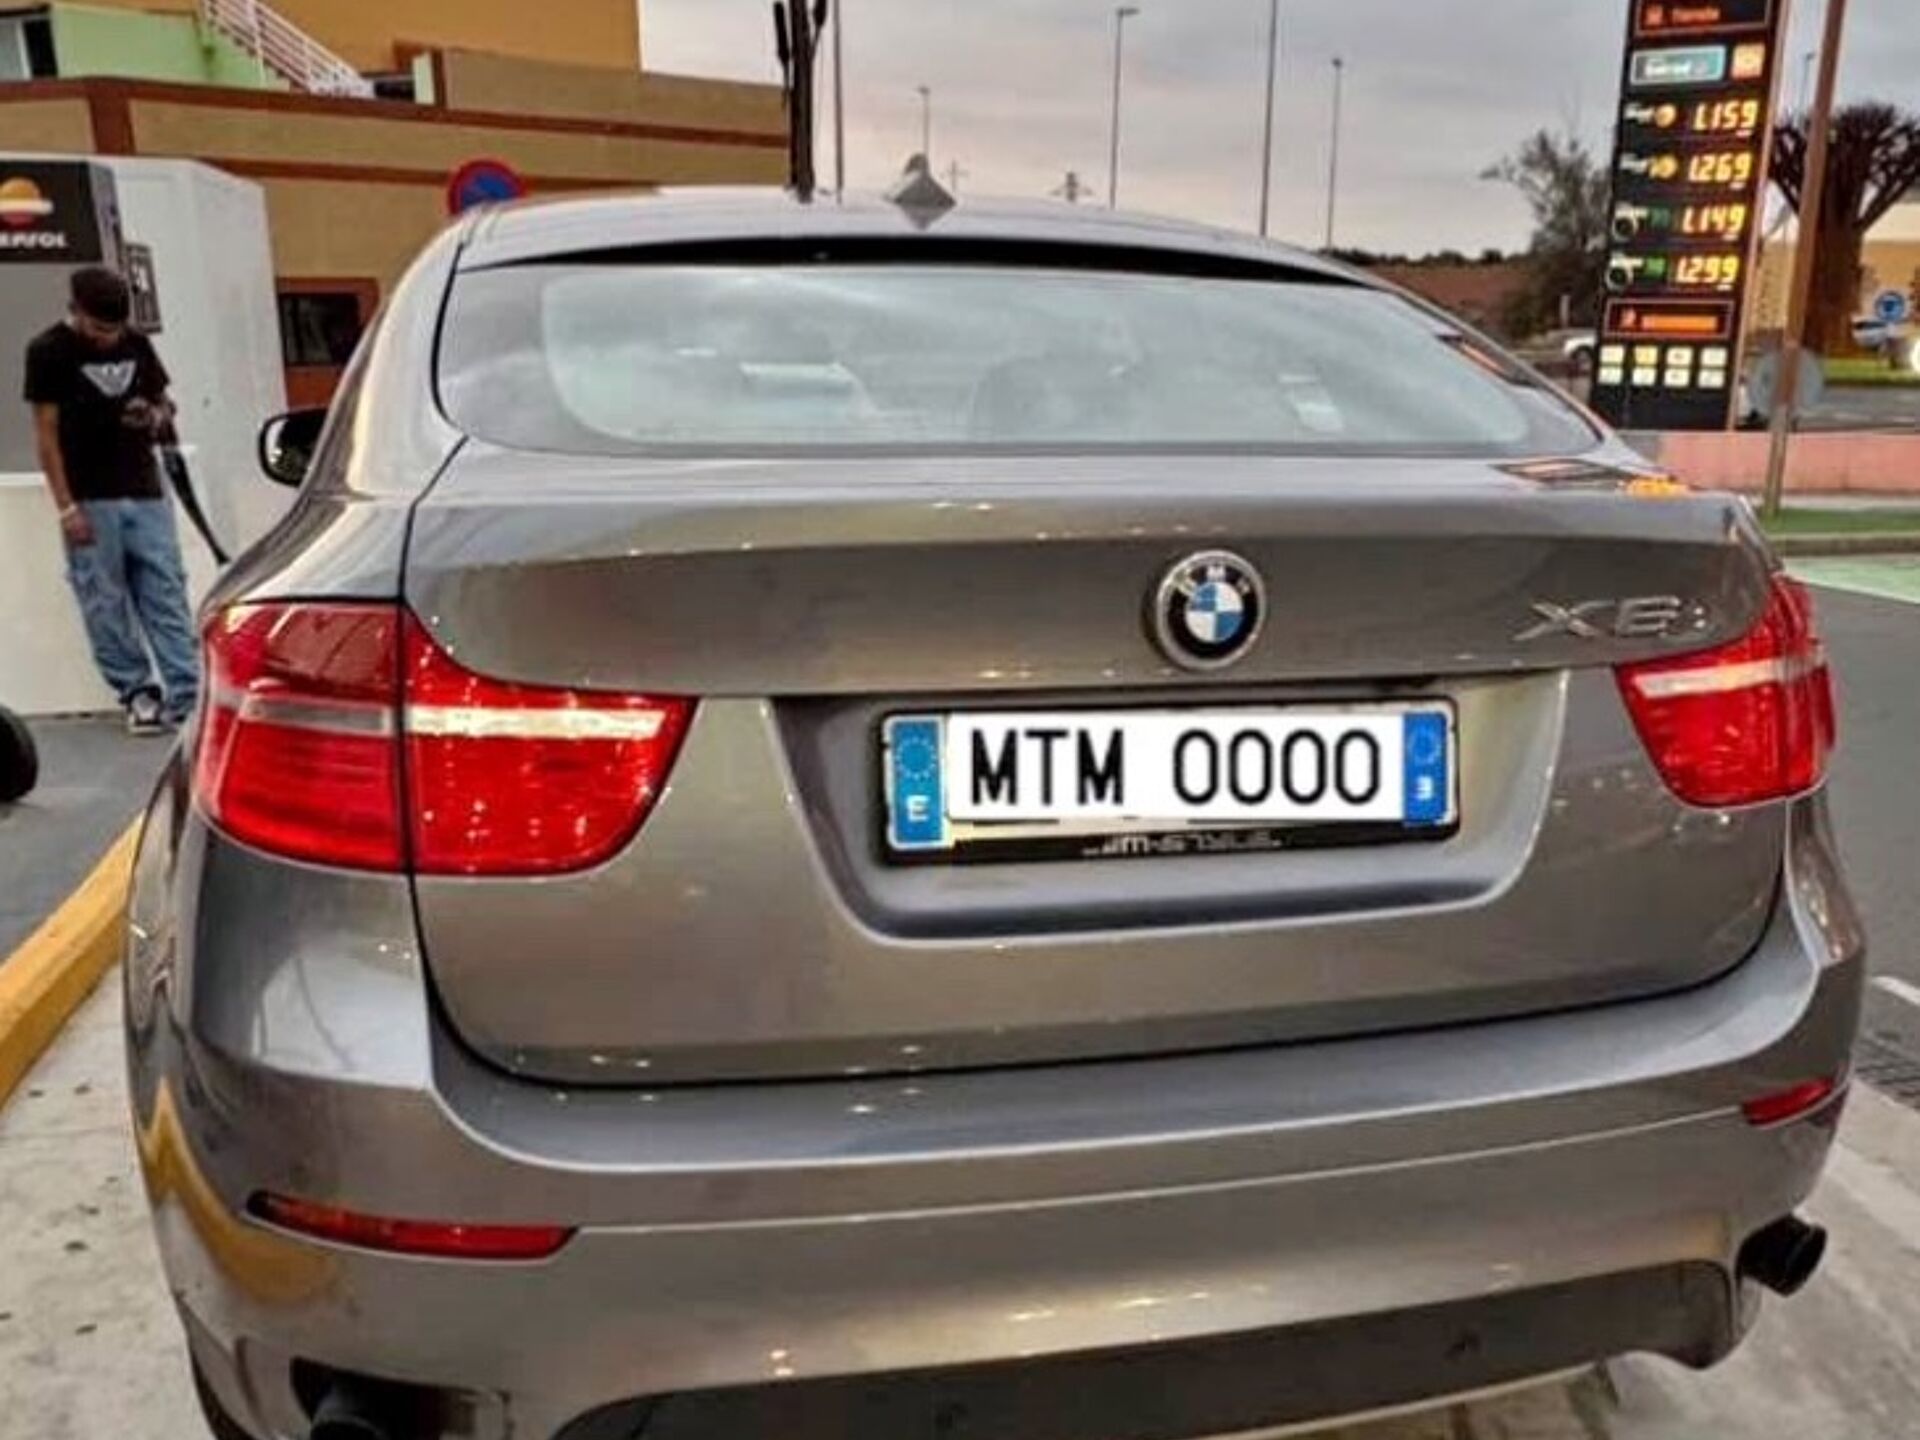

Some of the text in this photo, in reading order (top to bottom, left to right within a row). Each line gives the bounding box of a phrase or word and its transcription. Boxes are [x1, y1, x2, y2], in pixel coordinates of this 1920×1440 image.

[971, 728, 1381, 805] MTM 0000
[906, 795, 930, 822] E
